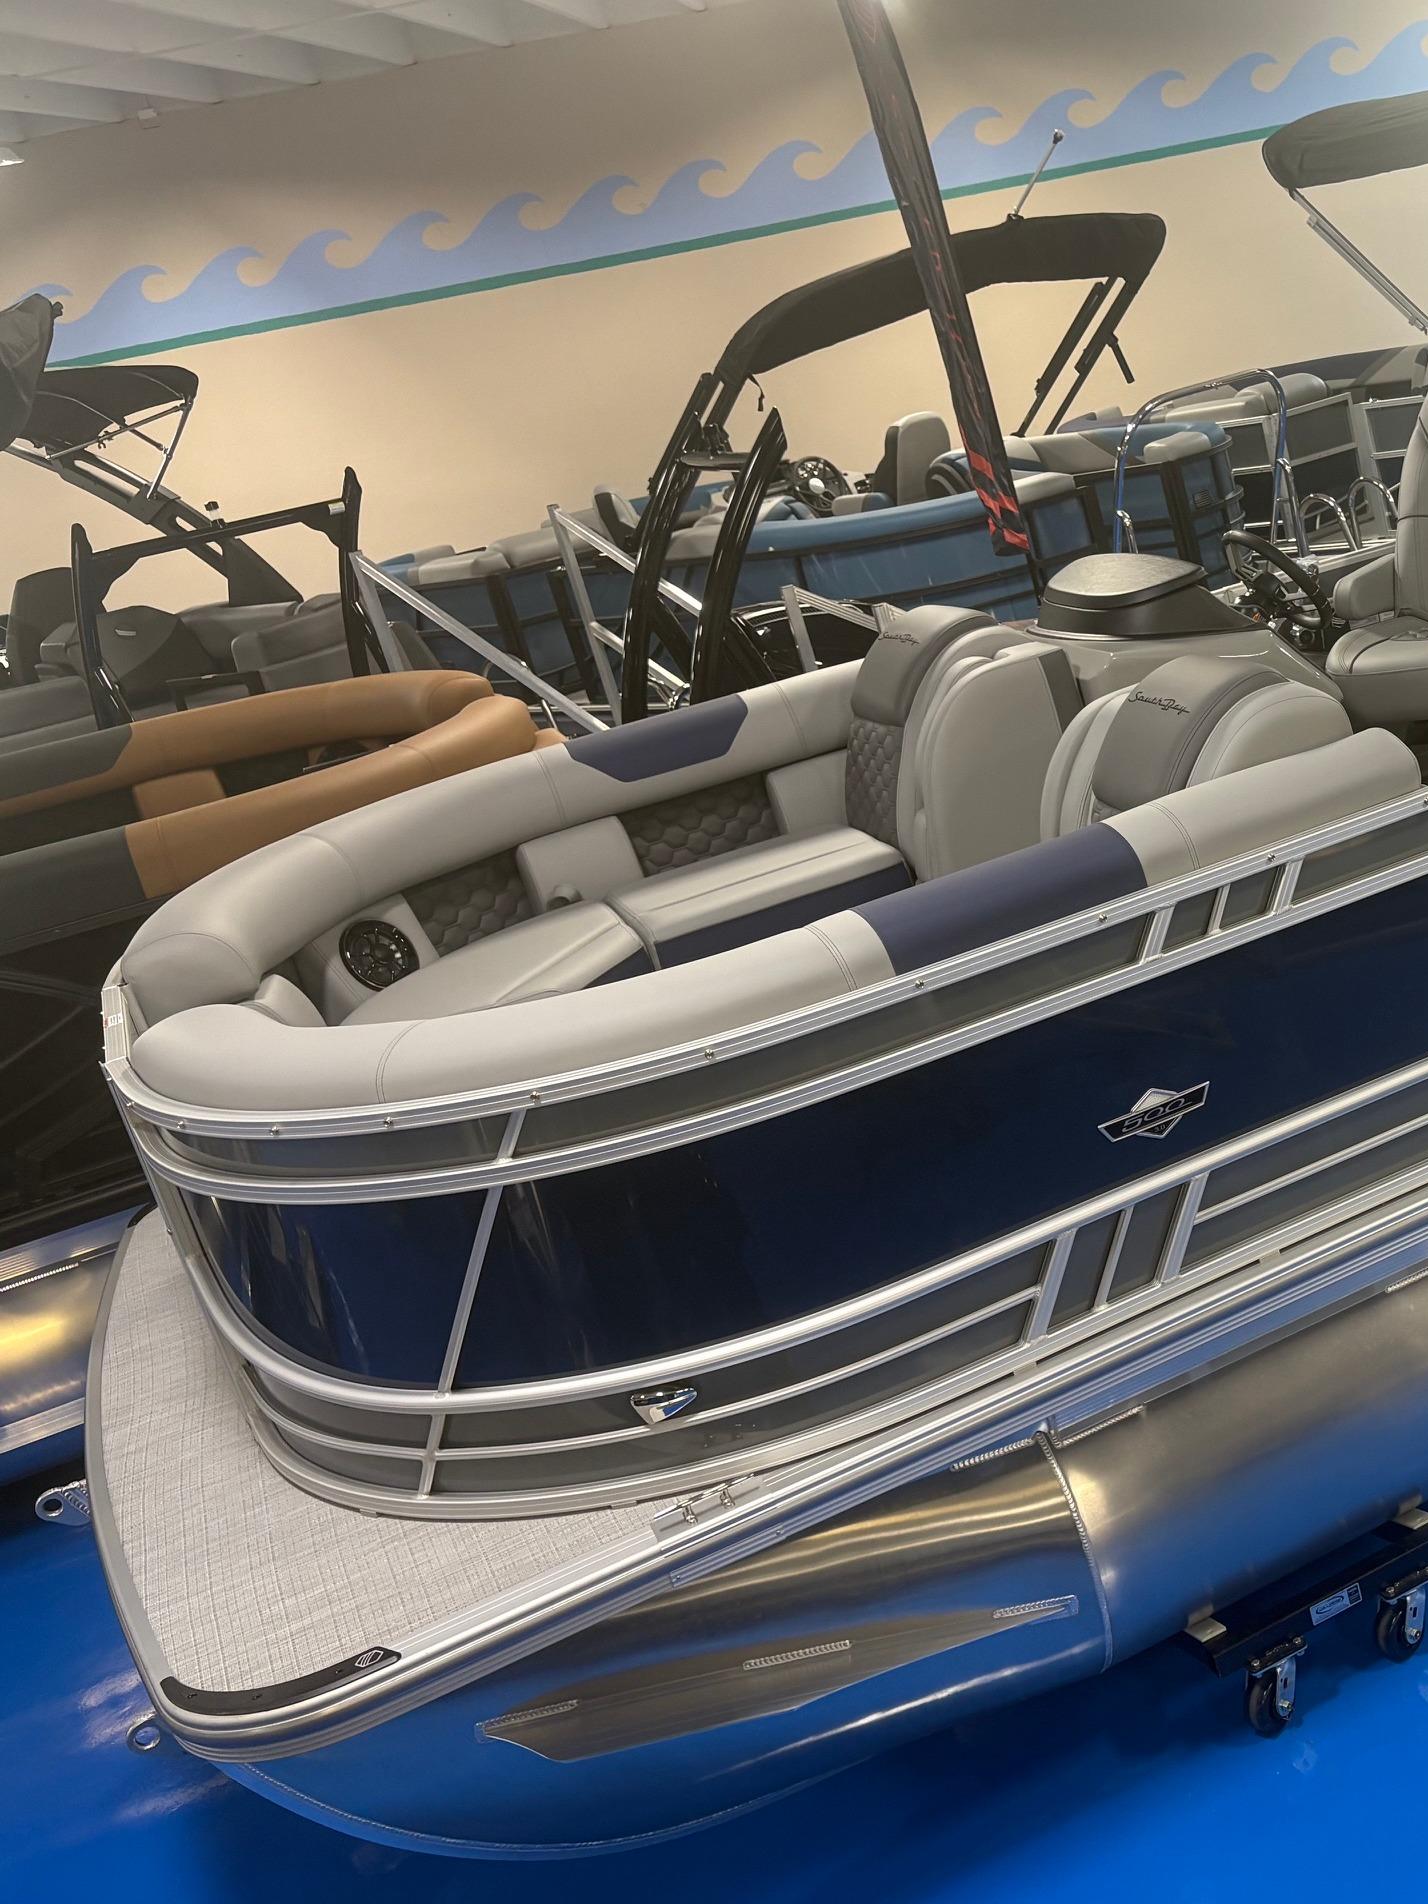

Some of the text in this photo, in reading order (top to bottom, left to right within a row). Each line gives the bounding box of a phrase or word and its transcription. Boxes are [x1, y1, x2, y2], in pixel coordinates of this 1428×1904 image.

[1127, 691, 1191, 715] South Bay
[1121, 1097, 1192, 1133] 500
